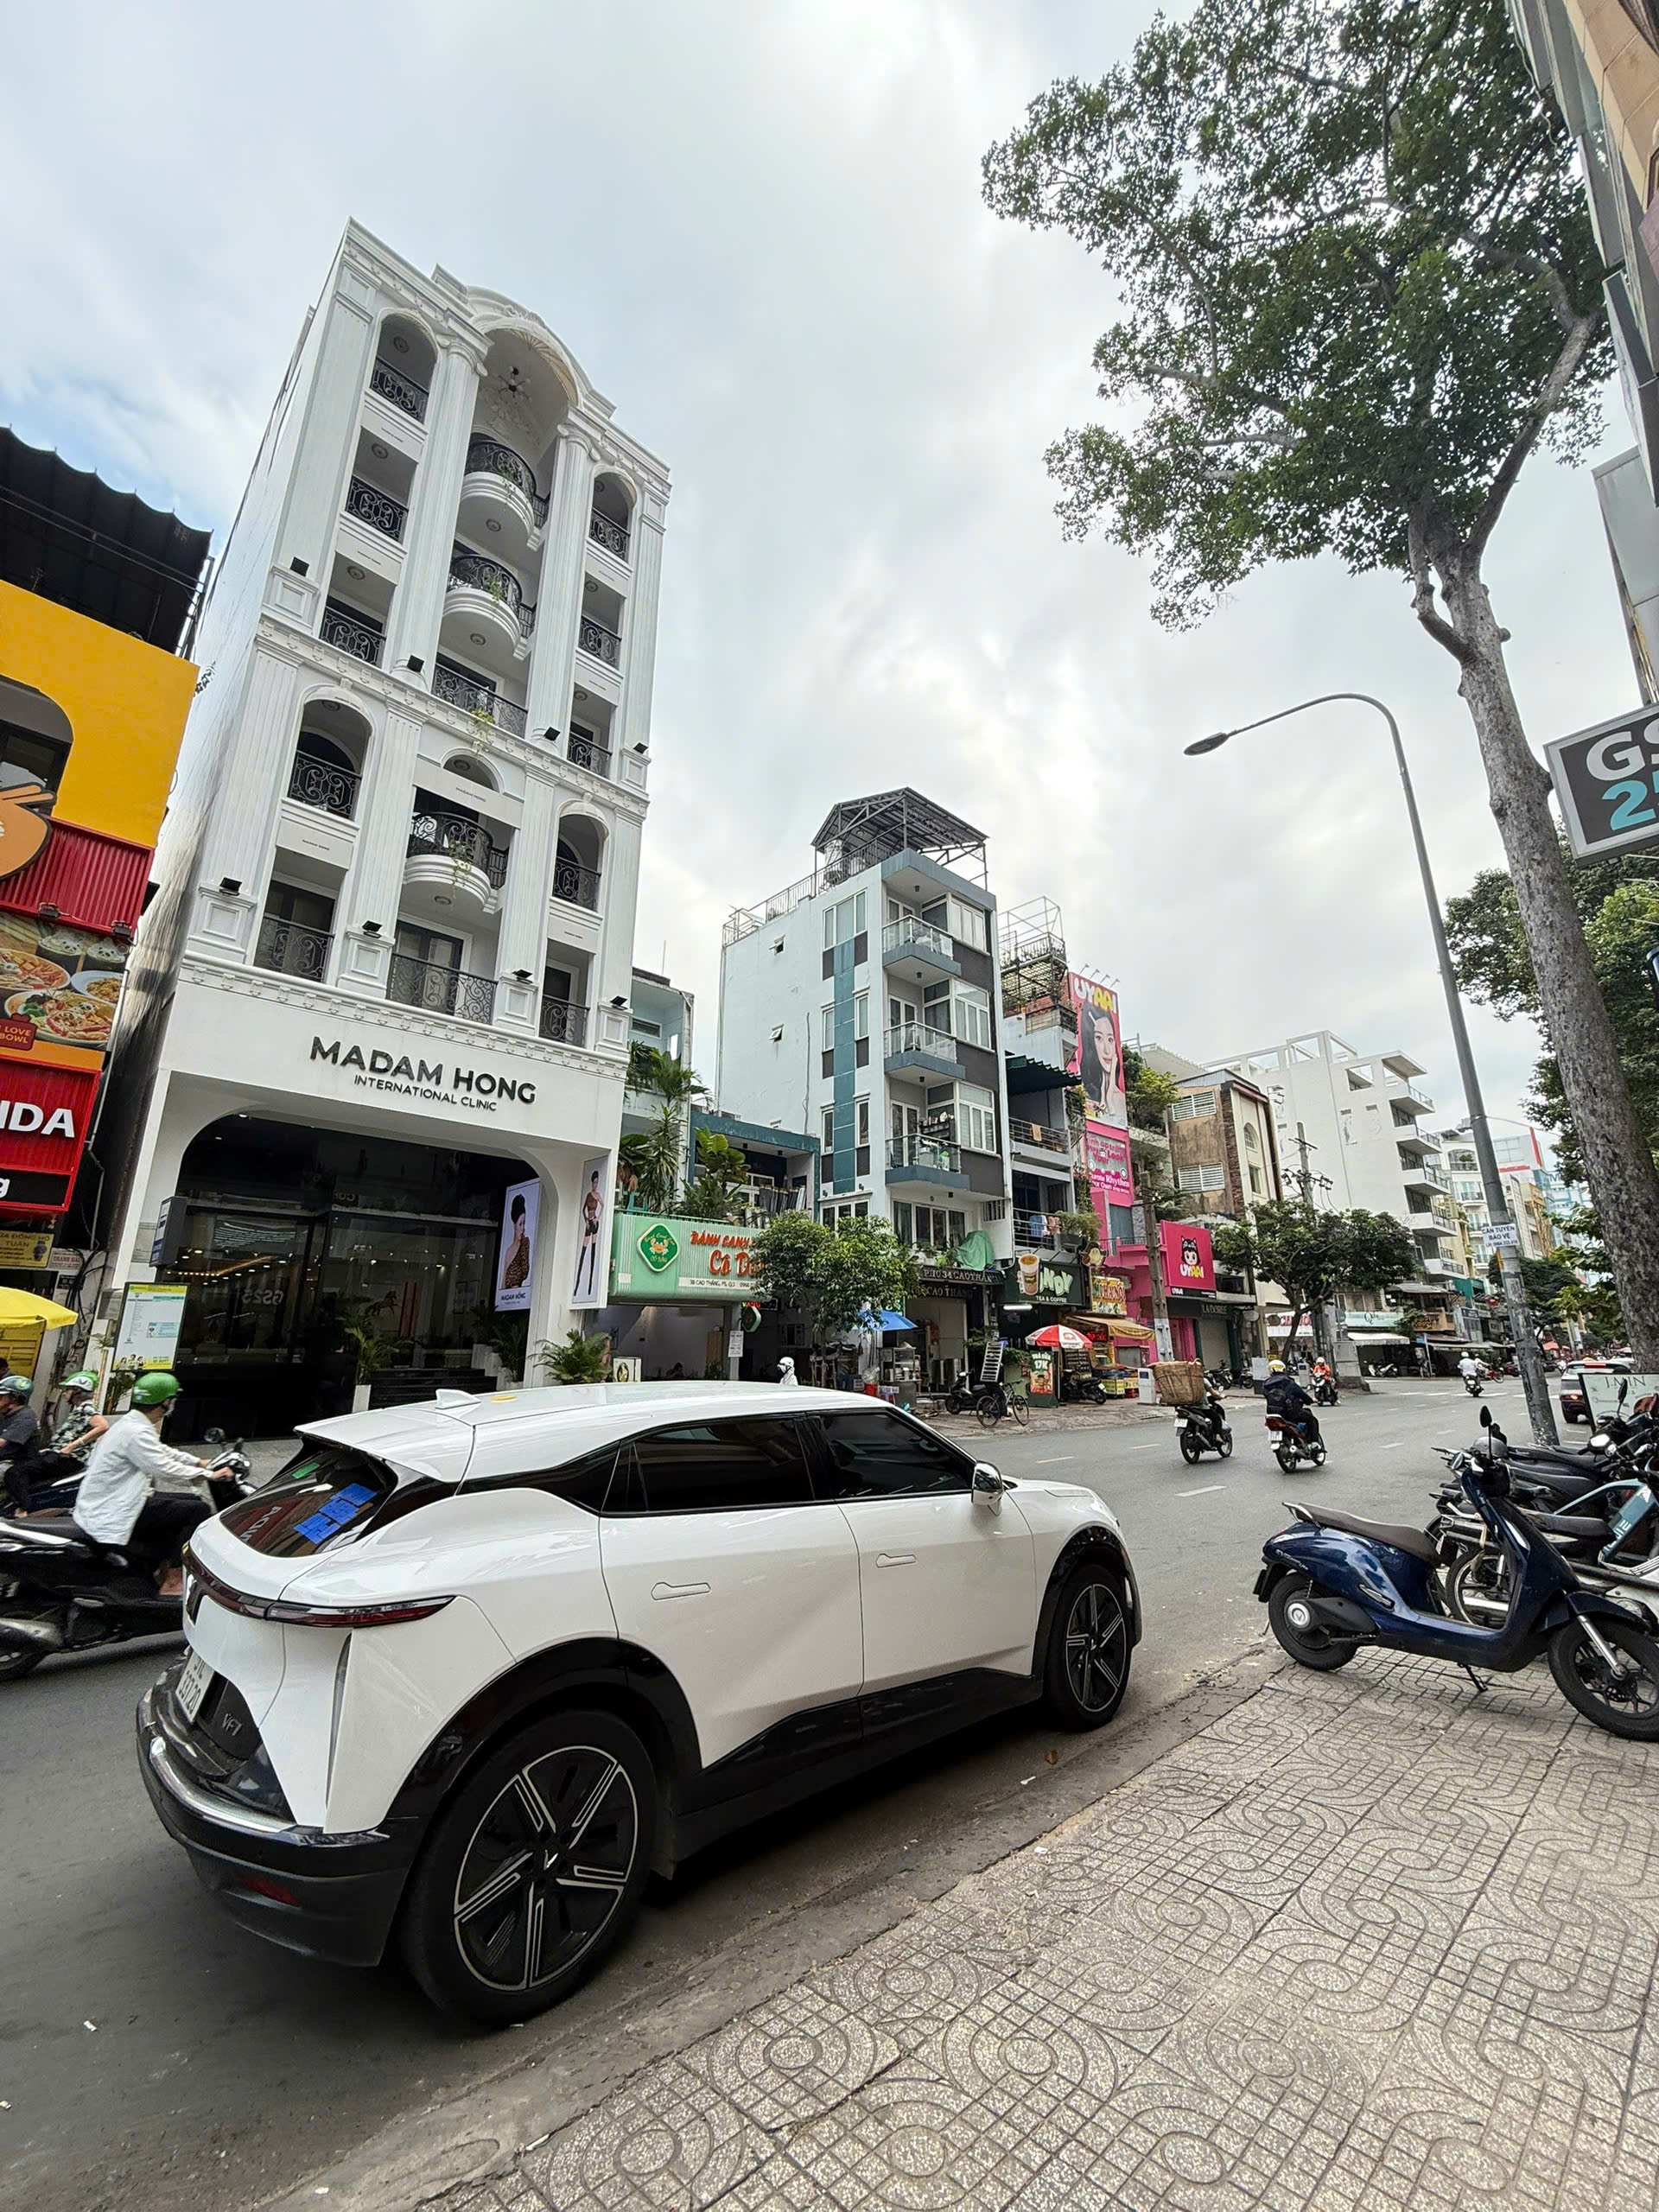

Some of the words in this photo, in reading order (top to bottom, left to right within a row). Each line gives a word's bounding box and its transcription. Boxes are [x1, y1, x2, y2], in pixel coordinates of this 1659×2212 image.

[1601, 769, 1659, 831] 2
[1074, 976, 1117, 1014] UYAAI
[4, 1026, 32, 1037] LOVE
[310, 1036, 443, 1087] MADAM
[454, 1067, 536, 1103] HONG
[354, 1074, 457, 1105] INTERNATIONAL
[461, 1096, 497, 1111] CLINIC
[1105, 1174, 1129, 1188] Rhythm
[690, 1230, 721, 1246] BÁNH
[721, 1235, 750, 1249] CANH
[709, 1249, 731, 1275] Cô
[1033, 1360, 1048, 1370] 17K
[222, 1713, 242, 1736] VF7
